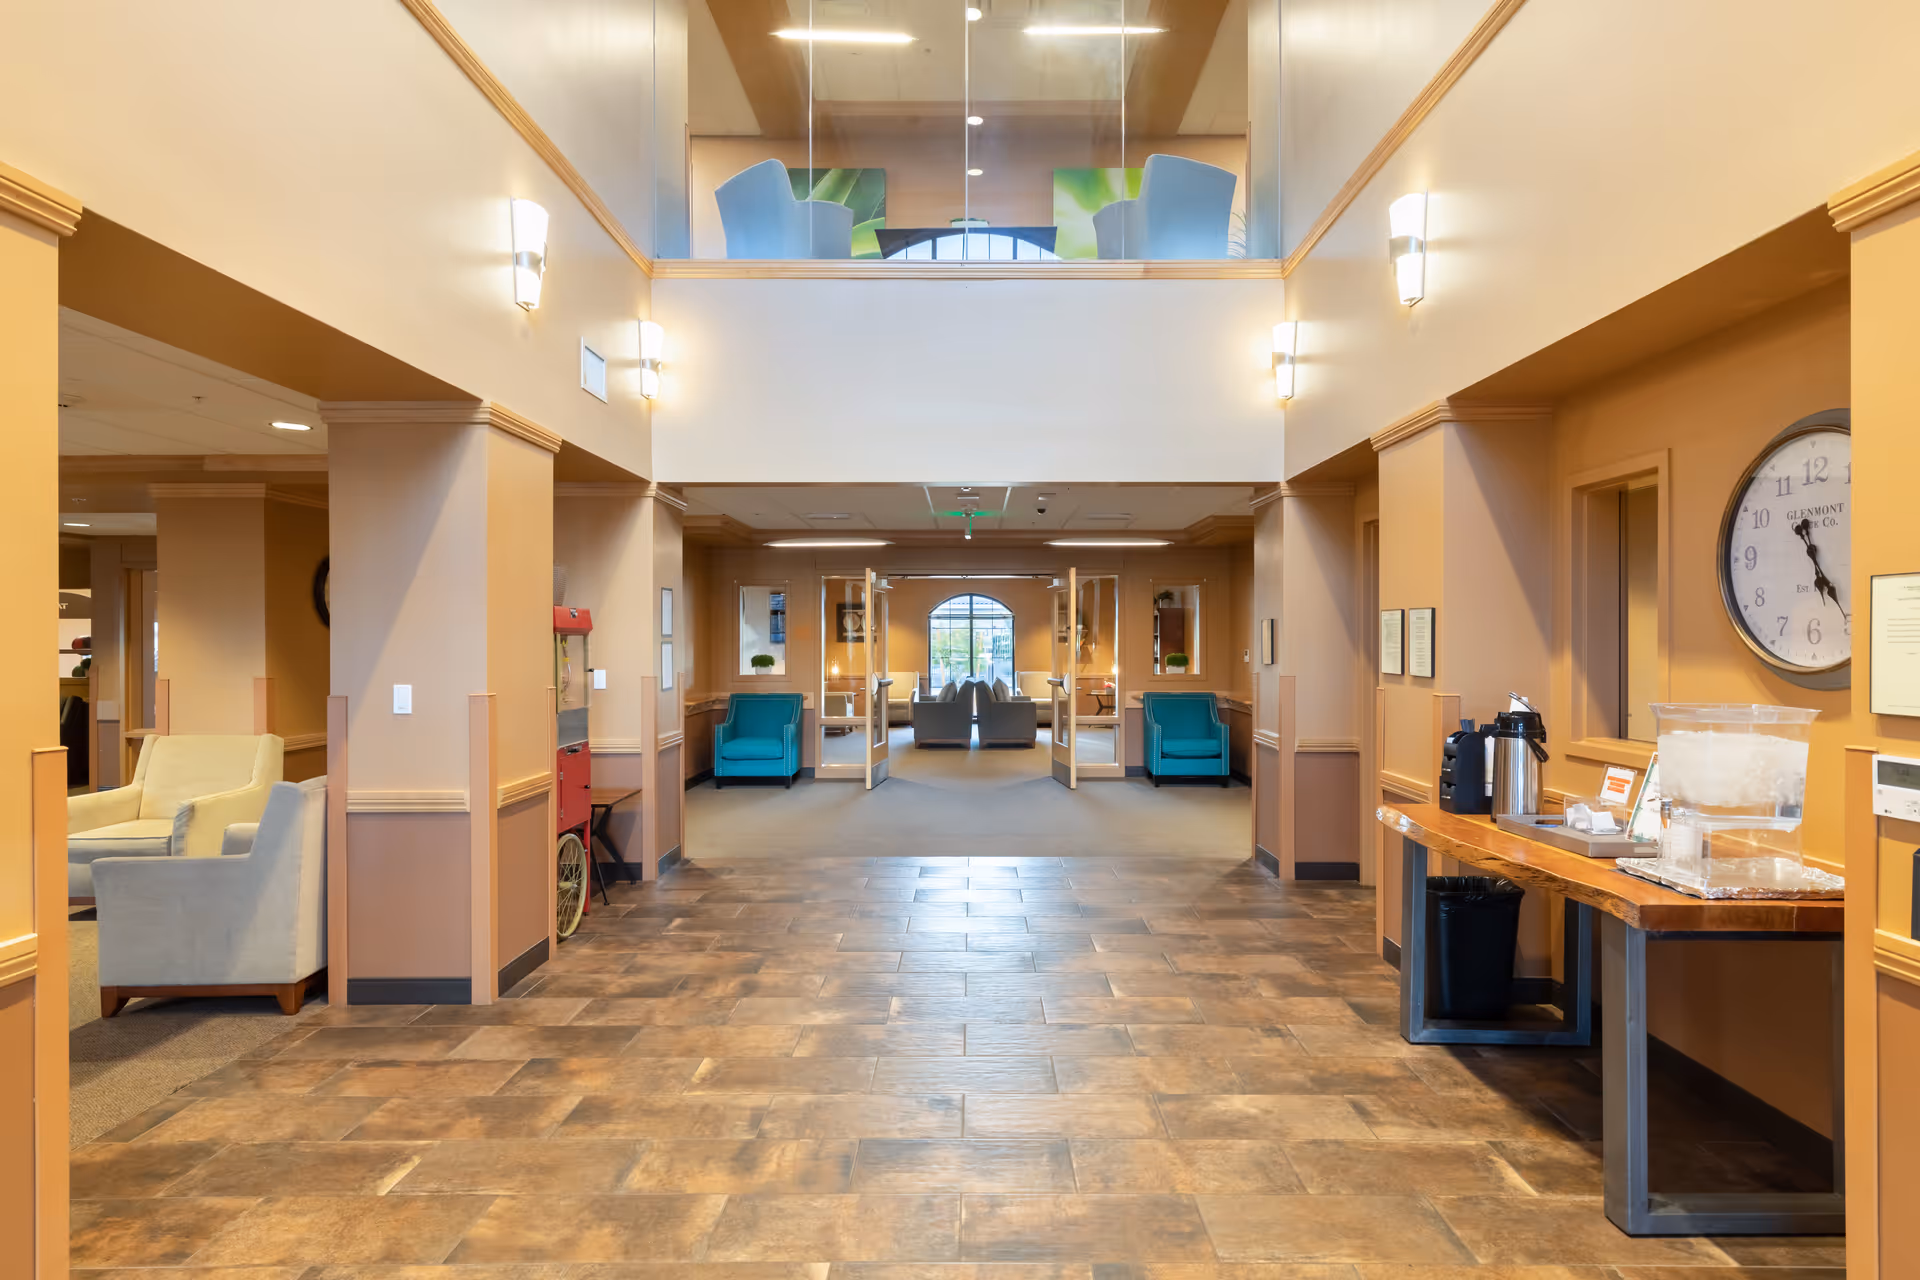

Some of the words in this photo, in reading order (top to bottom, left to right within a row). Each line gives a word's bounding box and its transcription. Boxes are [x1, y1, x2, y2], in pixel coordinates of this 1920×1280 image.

[1802, 456, 1828, 486] 12
[1776, 475, 1793, 497] 11
[1752, 508, 1770, 529] 10
[1786, 502, 1844, 520] GLENMONT
[1791, 520, 1819, 533] CCK
[1744, 546, 1757, 571] 9
[1755, 587, 1765, 607] 8
[1777, 616, 1788, 636] 7
[1806, 618, 1822, 645] 6
